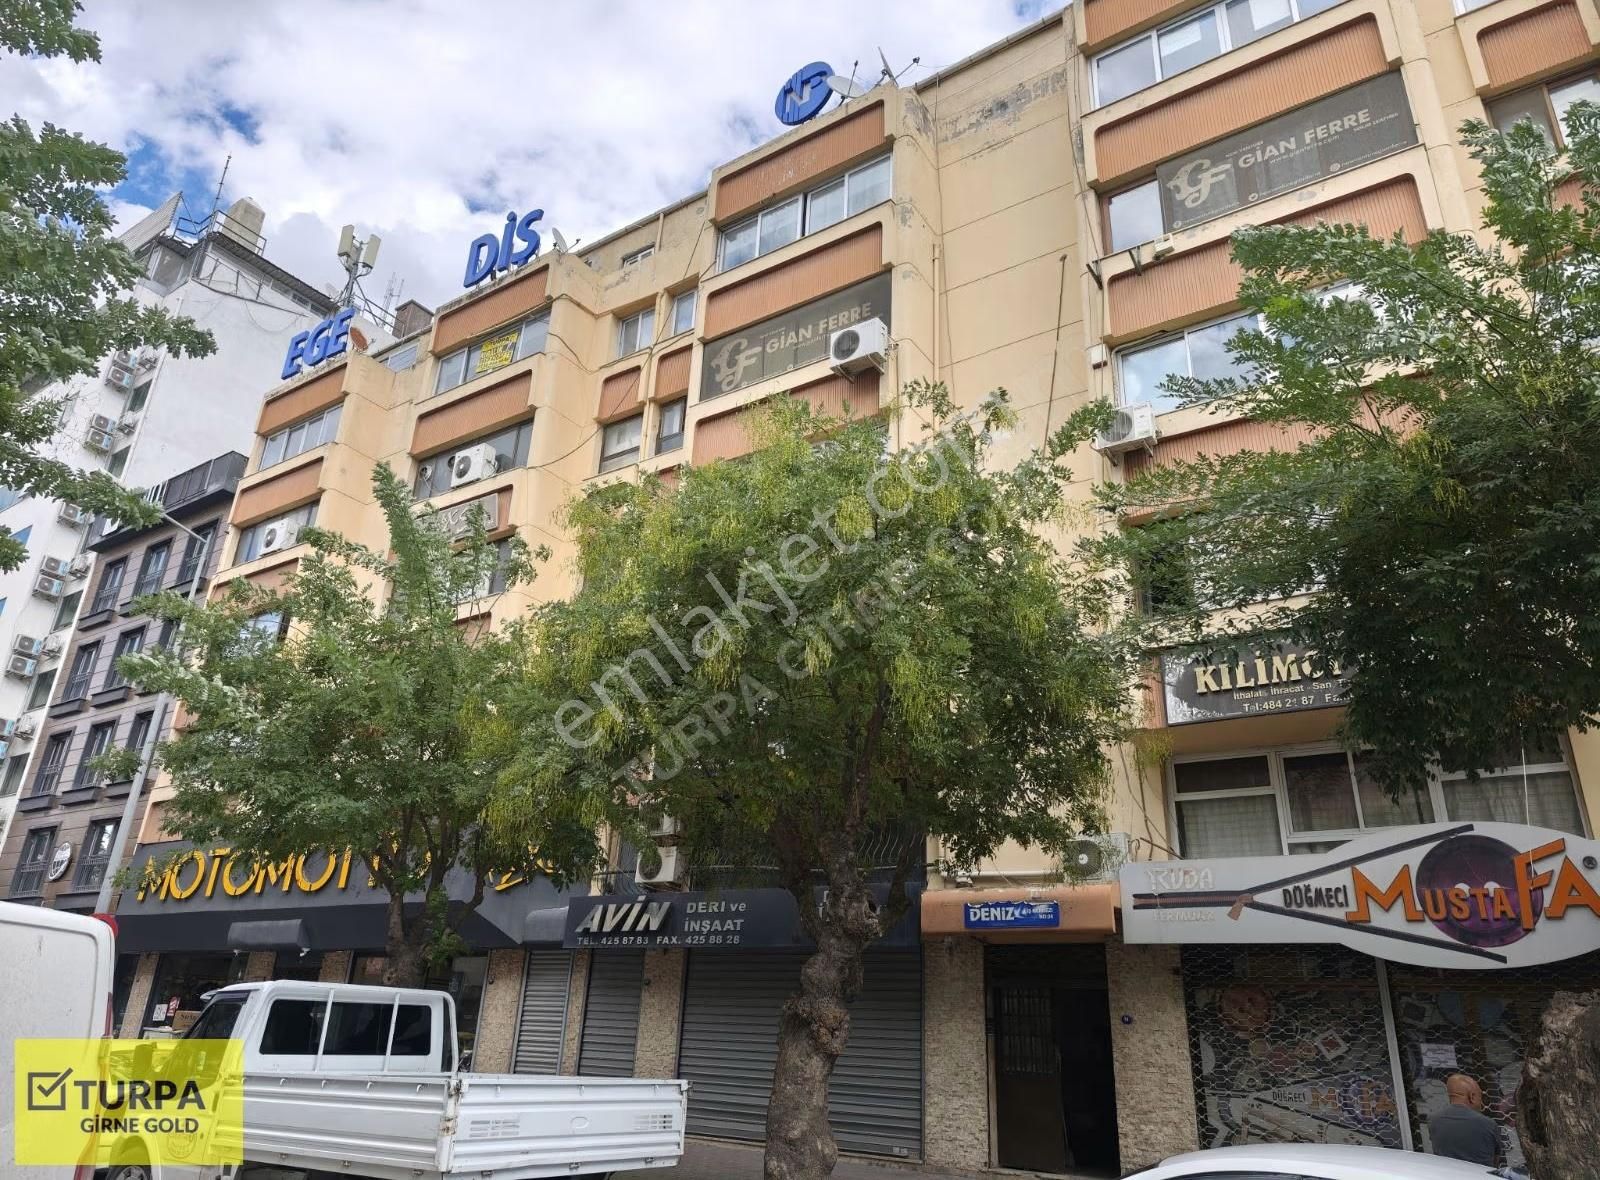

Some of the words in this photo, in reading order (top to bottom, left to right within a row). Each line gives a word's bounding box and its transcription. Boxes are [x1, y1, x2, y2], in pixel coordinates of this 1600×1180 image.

[1304, 108, 1371, 144] FERRE
[818, 302, 872, 334] FERRE
[281, 307, 355, 380] EGE
[1301, 695, 1314, 705] 87
[1346, 838, 1600, 931] MUSTAFA
[575, 895, 671, 933] AVİN
[730, 902, 746, 912] ve
[600, 936, 620, 945] 425
[622, 936, 634, 945] 87
[656, 935, 681, 945] FAX.
[685, 935, 705, 944] 425
[684, 917, 745, 935] İNŞAAT
